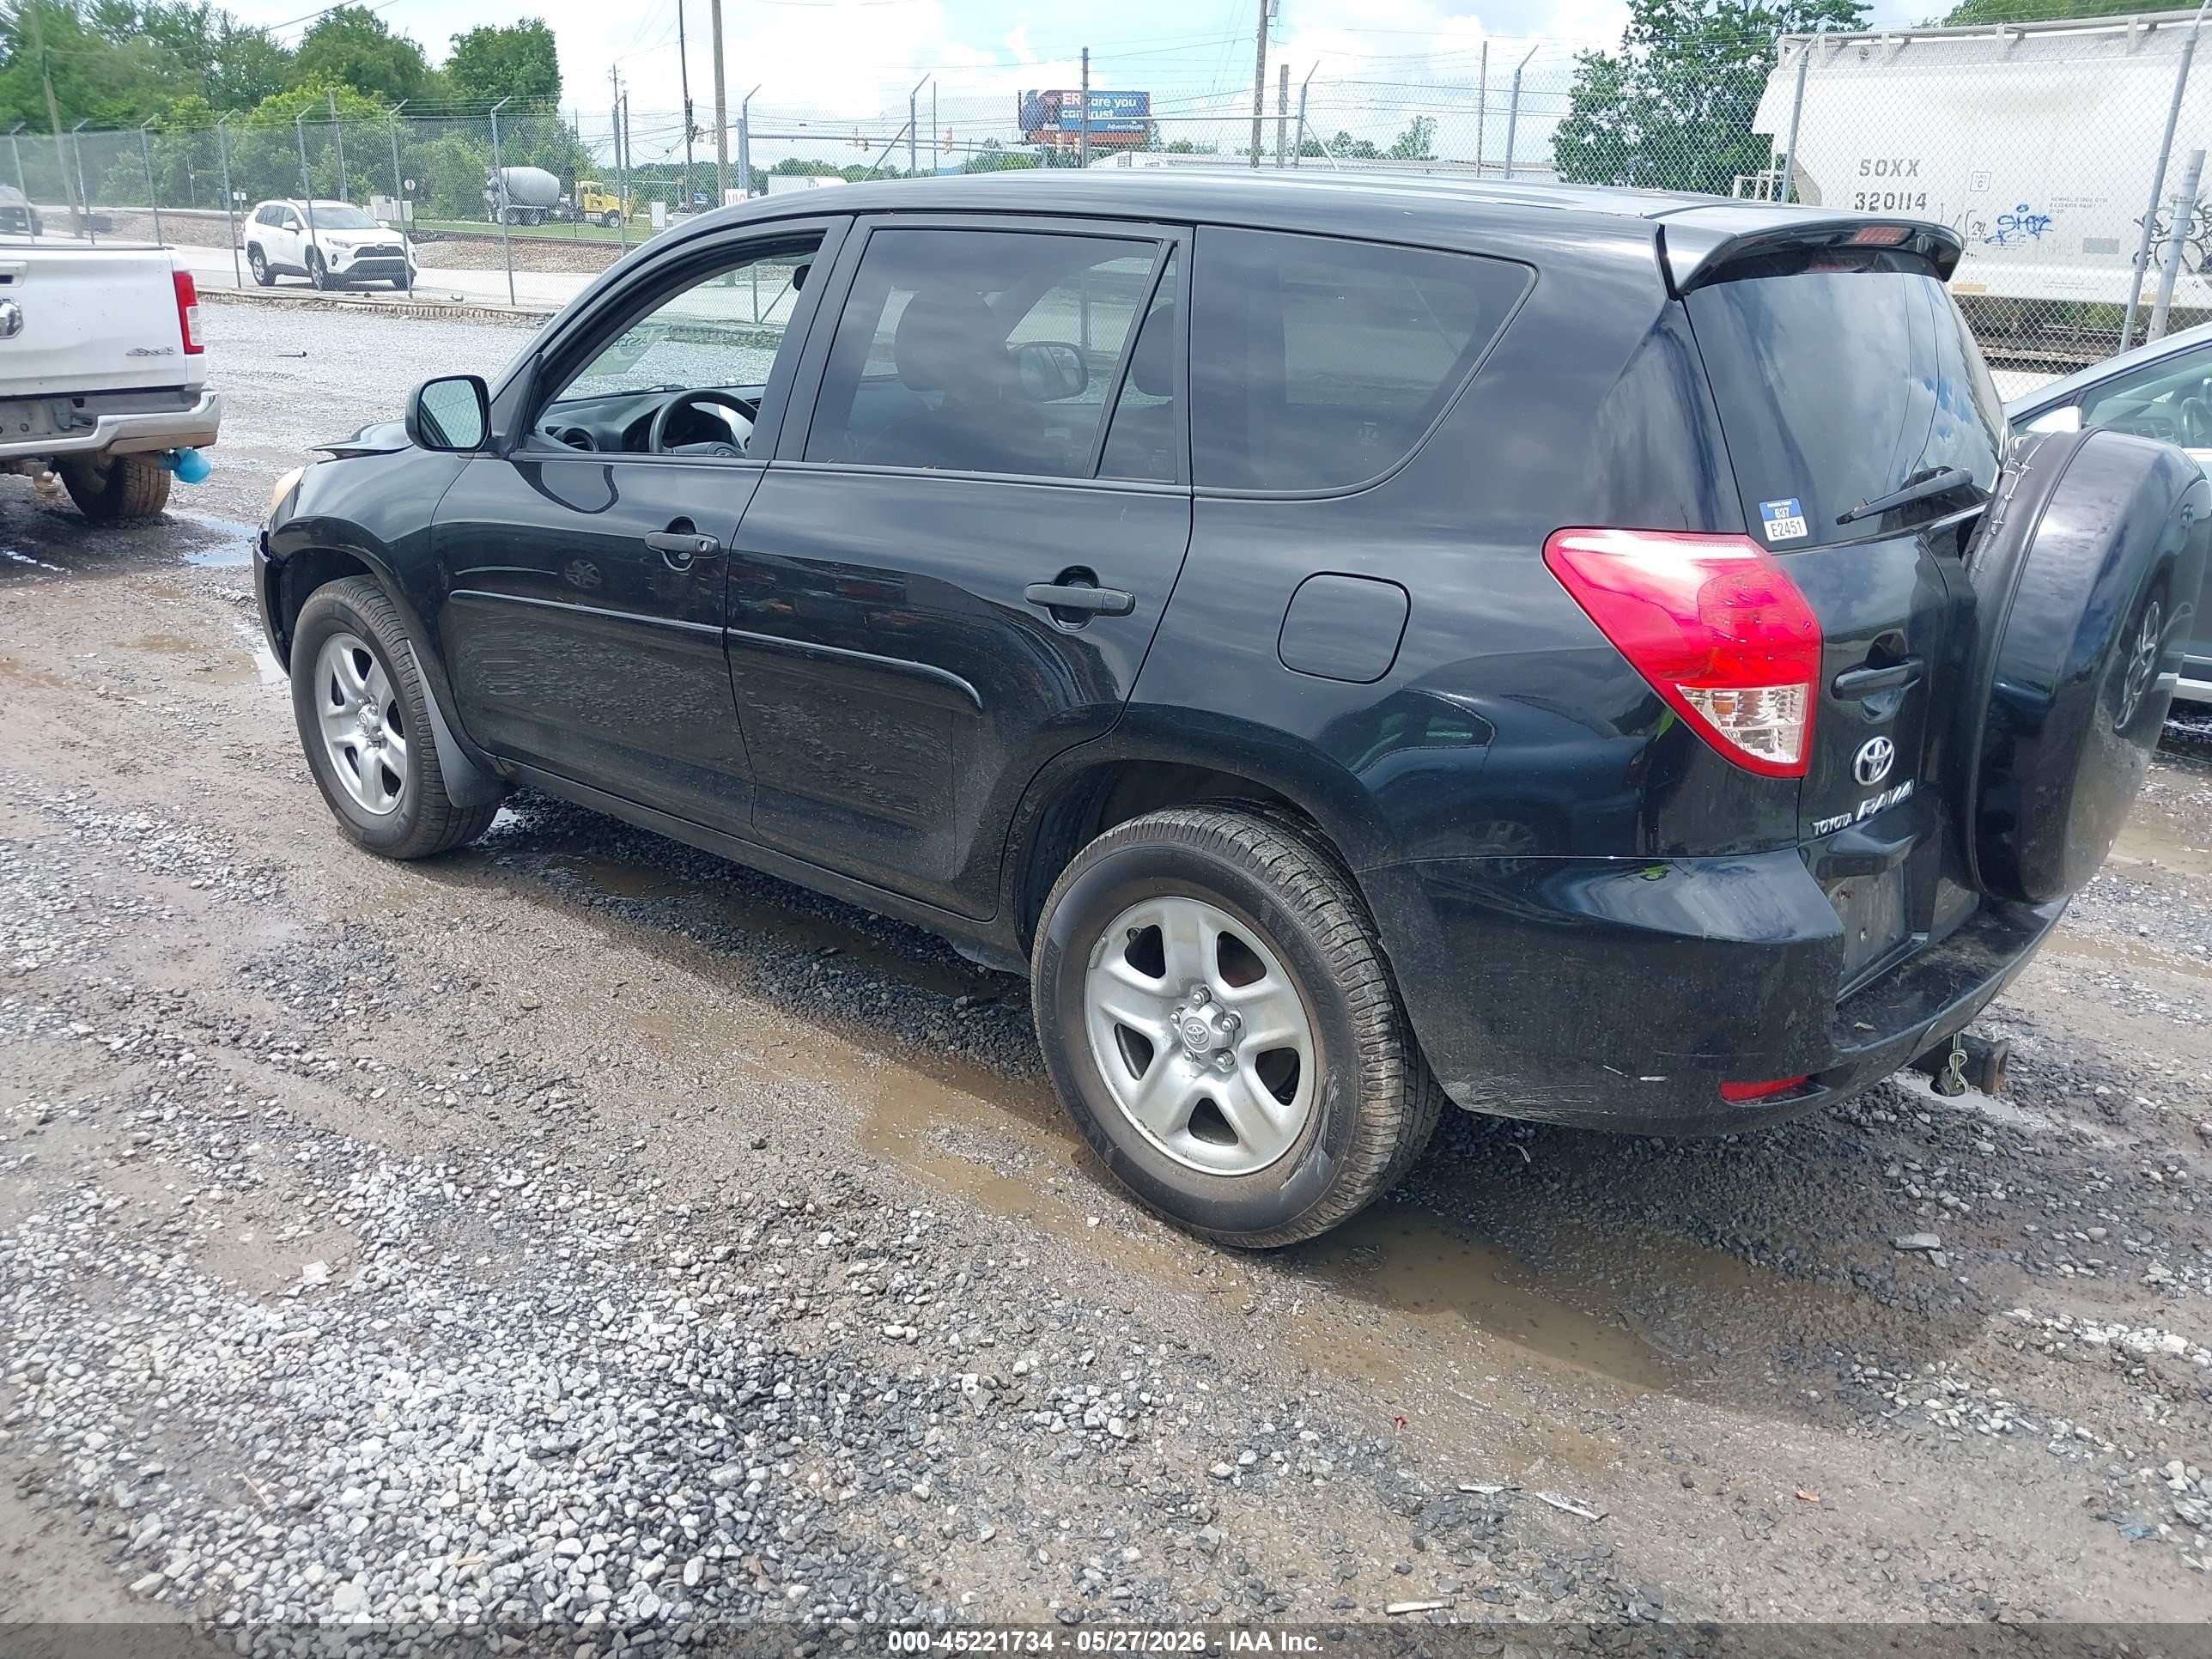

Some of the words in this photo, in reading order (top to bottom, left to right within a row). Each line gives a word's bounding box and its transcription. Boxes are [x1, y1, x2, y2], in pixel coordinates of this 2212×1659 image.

[1062, 93, 1081, 105] ER
[1087, 97, 1113, 106] are
[1115, 97, 1137, 108] you
[1088, 109, 1115, 118] rust
[1858, 159, 1921, 177] SOXX
[1977, 179, 1984, 188] C
[1854, 191, 1927, 212] 320114
[1774, 507, 1790, 519] 637
[1771, 520, 1803, 538] E2451
[1813, 812, 1852, 836] TOYOTA
[1856, 779, 1914, 822] RAV4
